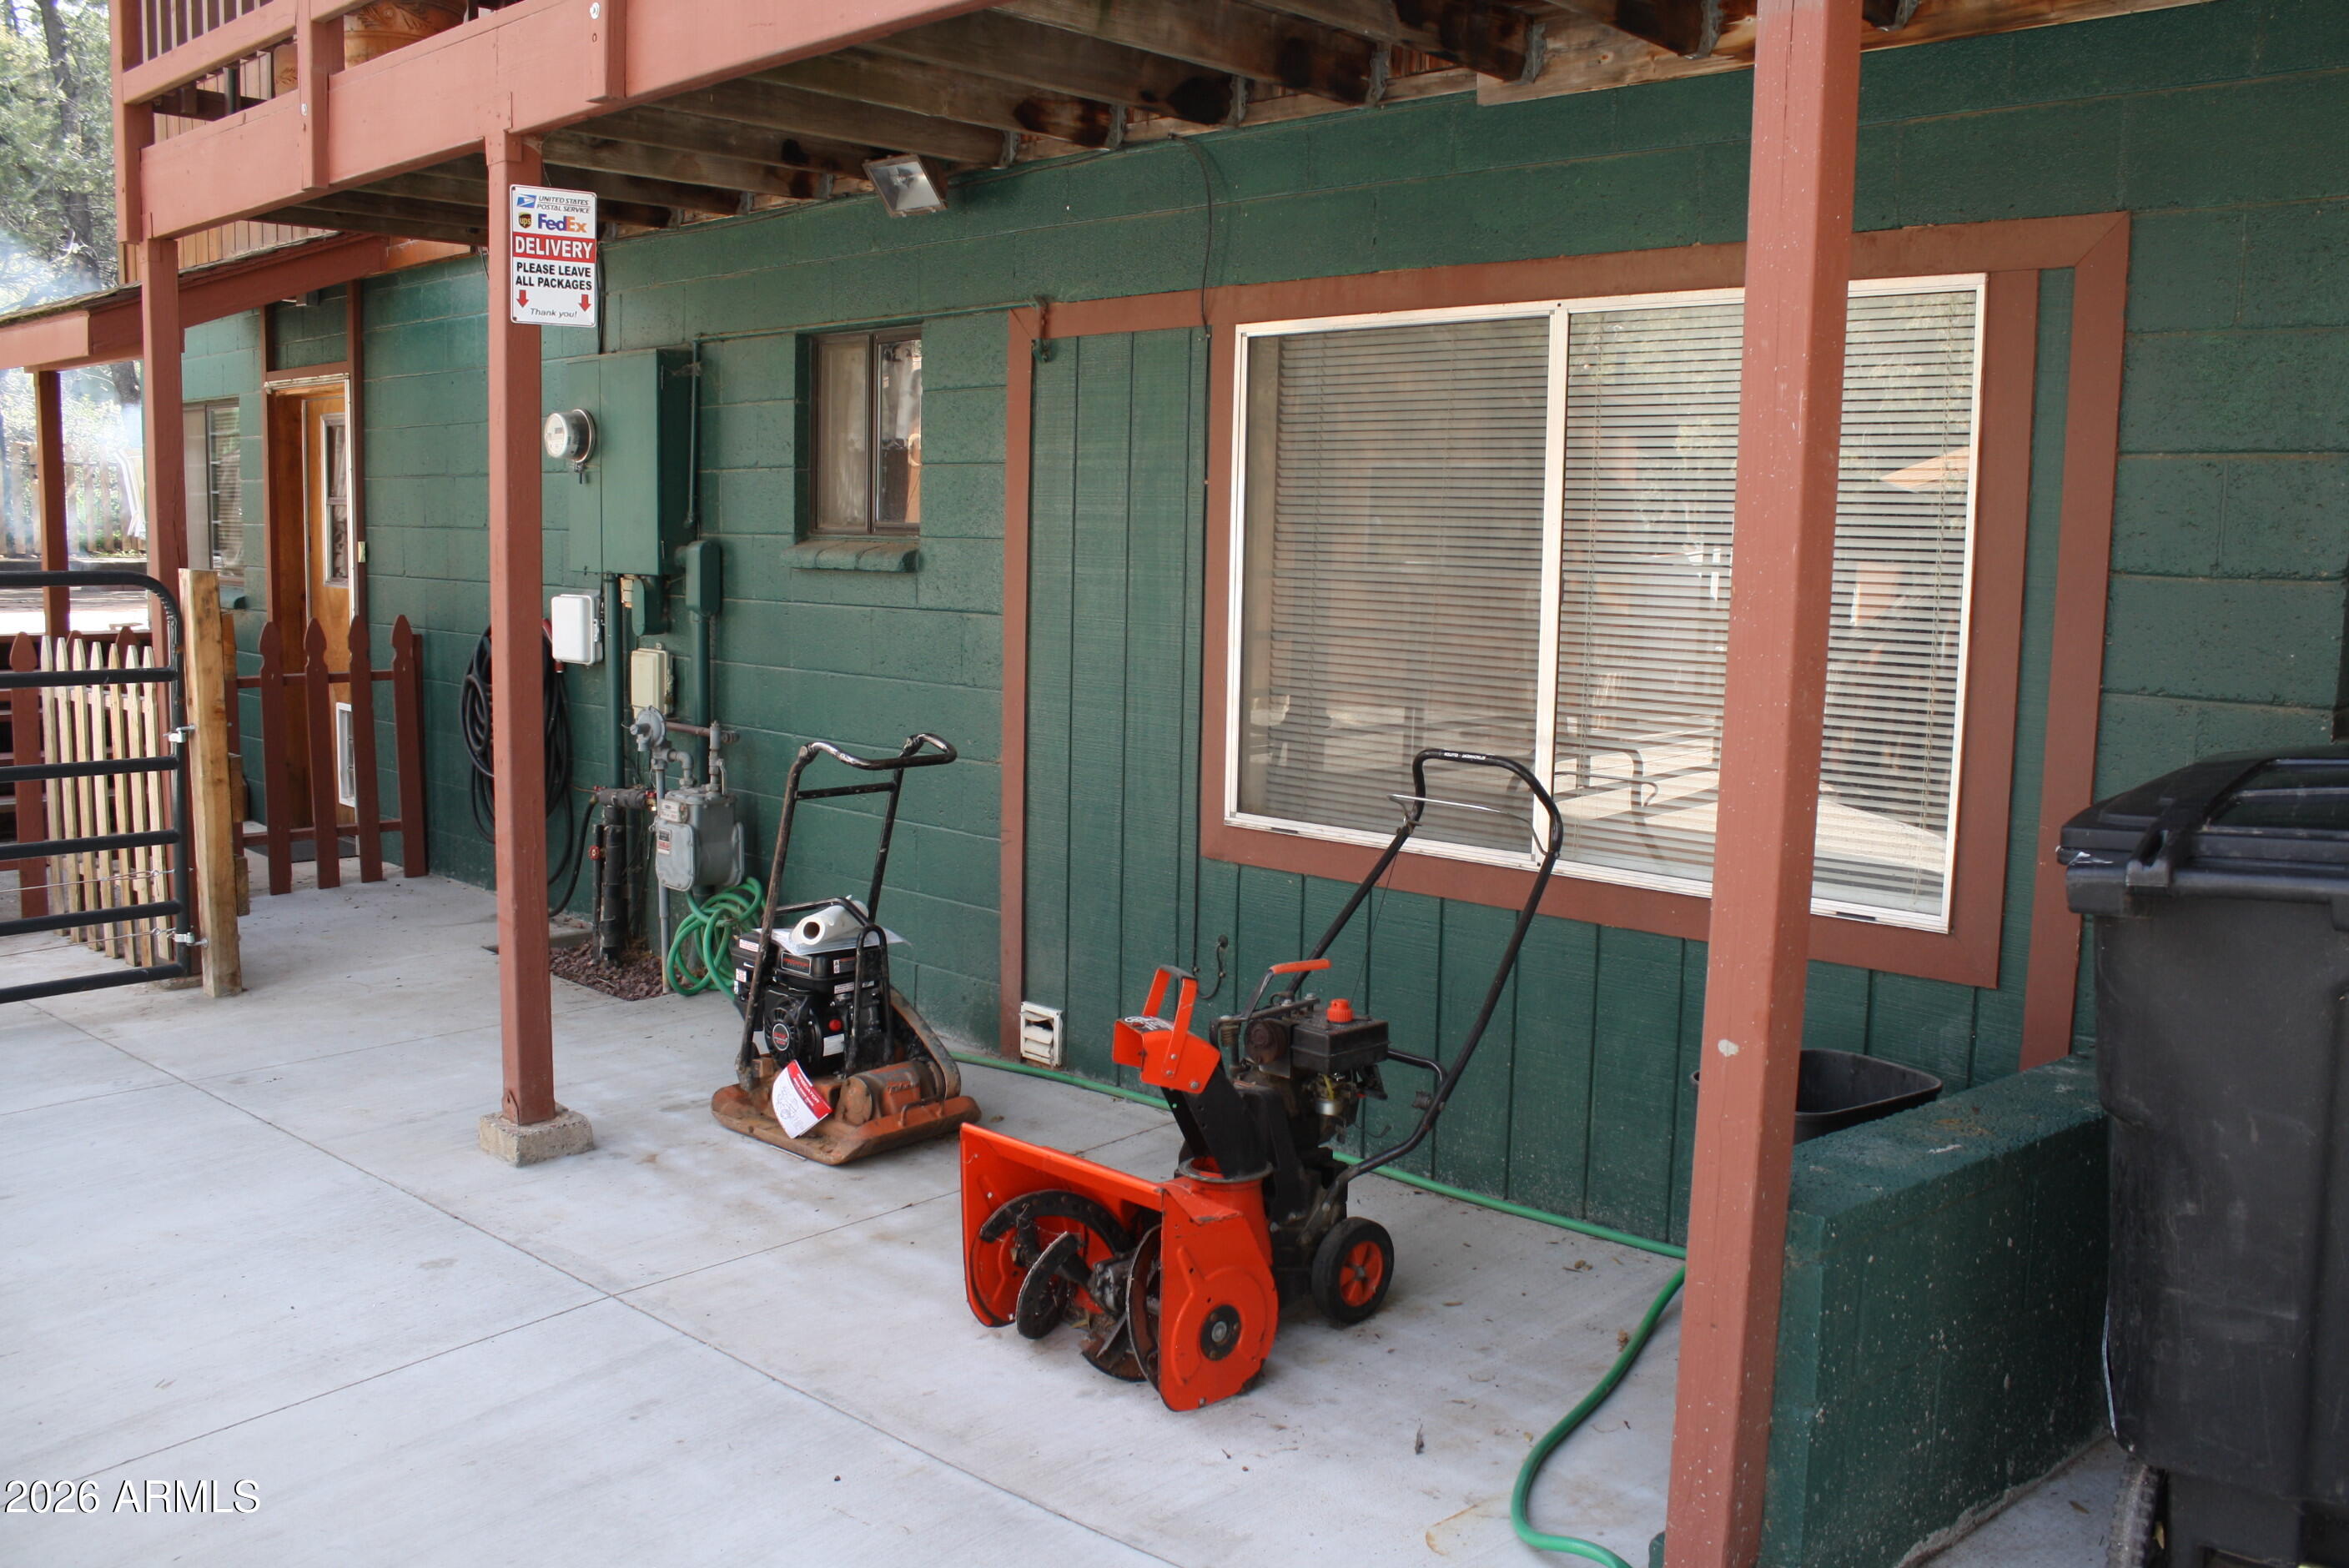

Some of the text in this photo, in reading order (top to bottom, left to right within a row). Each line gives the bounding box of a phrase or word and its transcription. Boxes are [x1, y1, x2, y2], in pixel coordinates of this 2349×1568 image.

[538, 195, 565, 204] UNITED
[520, 218, 531, 227] ups
[538, 213, 587, 234] FedEx
[515, 235, 593, 259] DELIVERY
[516, 261, 591, 278] PLEASE LEAVE
[516, 275, 592, 290] ALL PACKAGES
[530, 307, 556, 316] Thank
